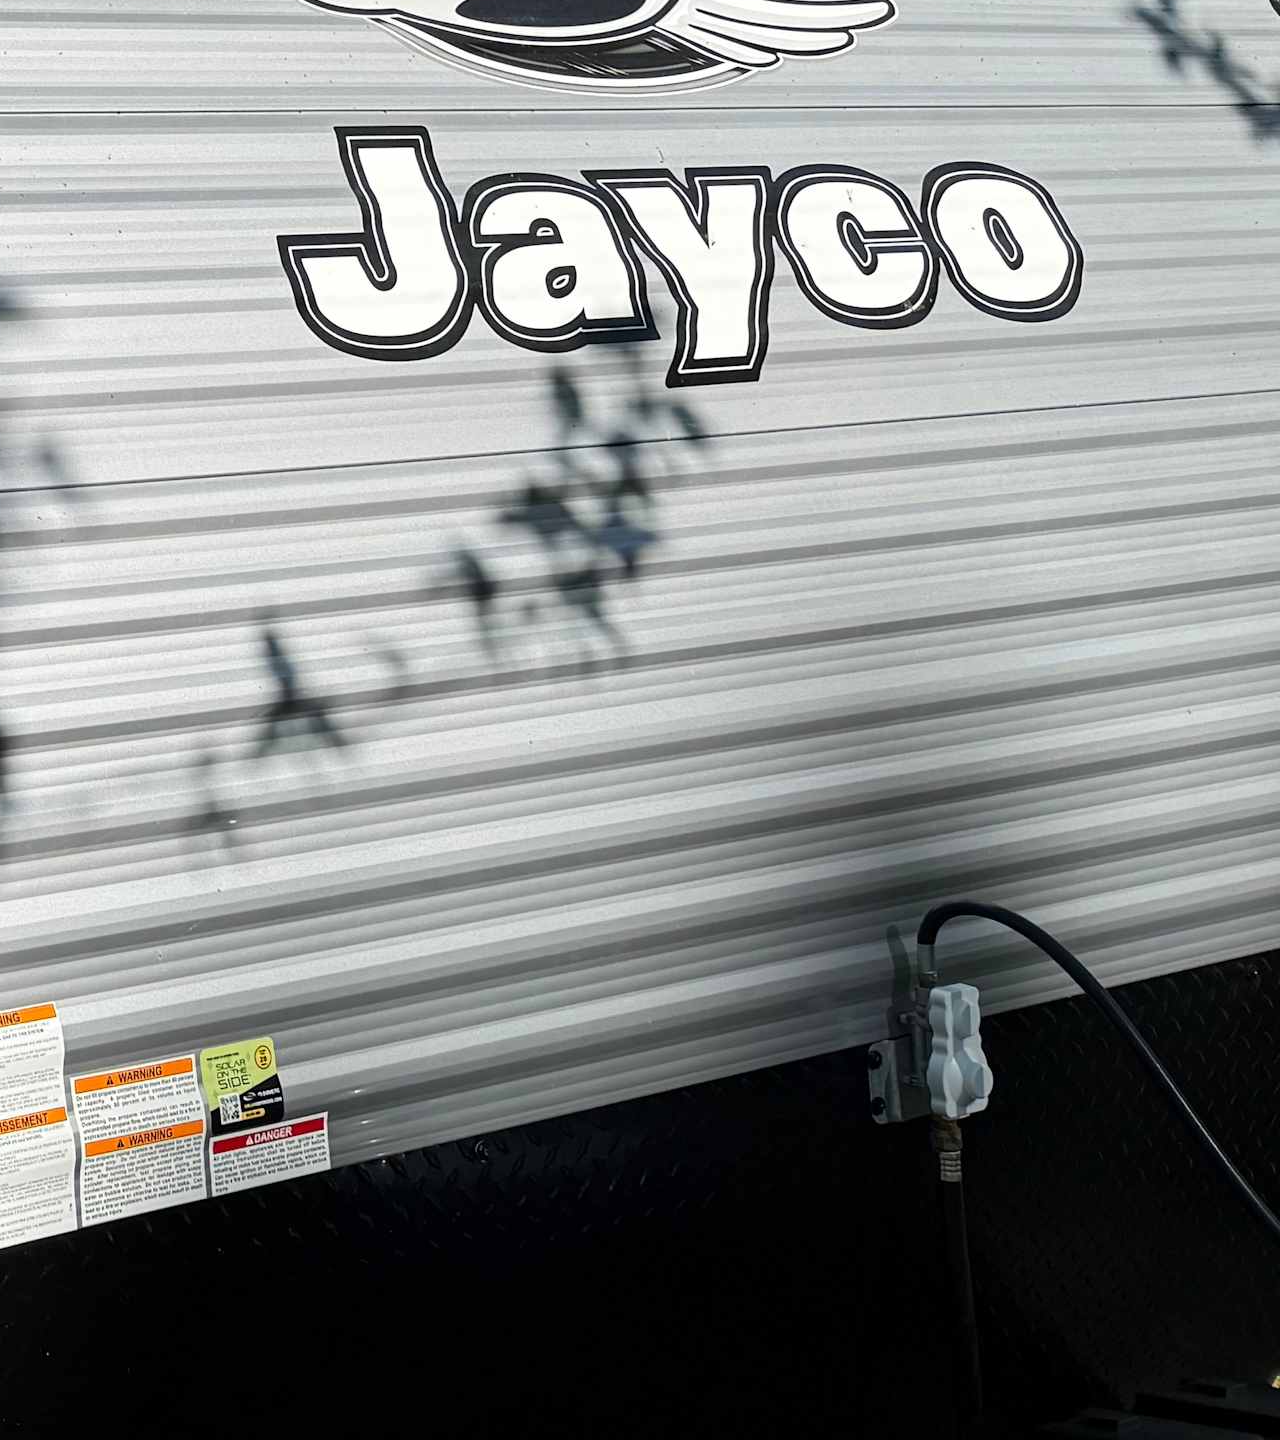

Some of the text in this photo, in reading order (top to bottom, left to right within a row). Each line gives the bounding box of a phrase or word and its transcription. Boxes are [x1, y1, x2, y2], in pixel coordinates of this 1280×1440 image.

[276, 125, 1085, 388] Jayco
[215, 1058, 246, 1072] SOLAR
[216, 1066, 248, 1079] ON THE
[118, 1066, 163, 1084] WARNING
[217, 1074, 251, 1090] SIDE
[128, 1127, 173, 1146] WARNING
[253, 1126, 293, 1144] DANGER
